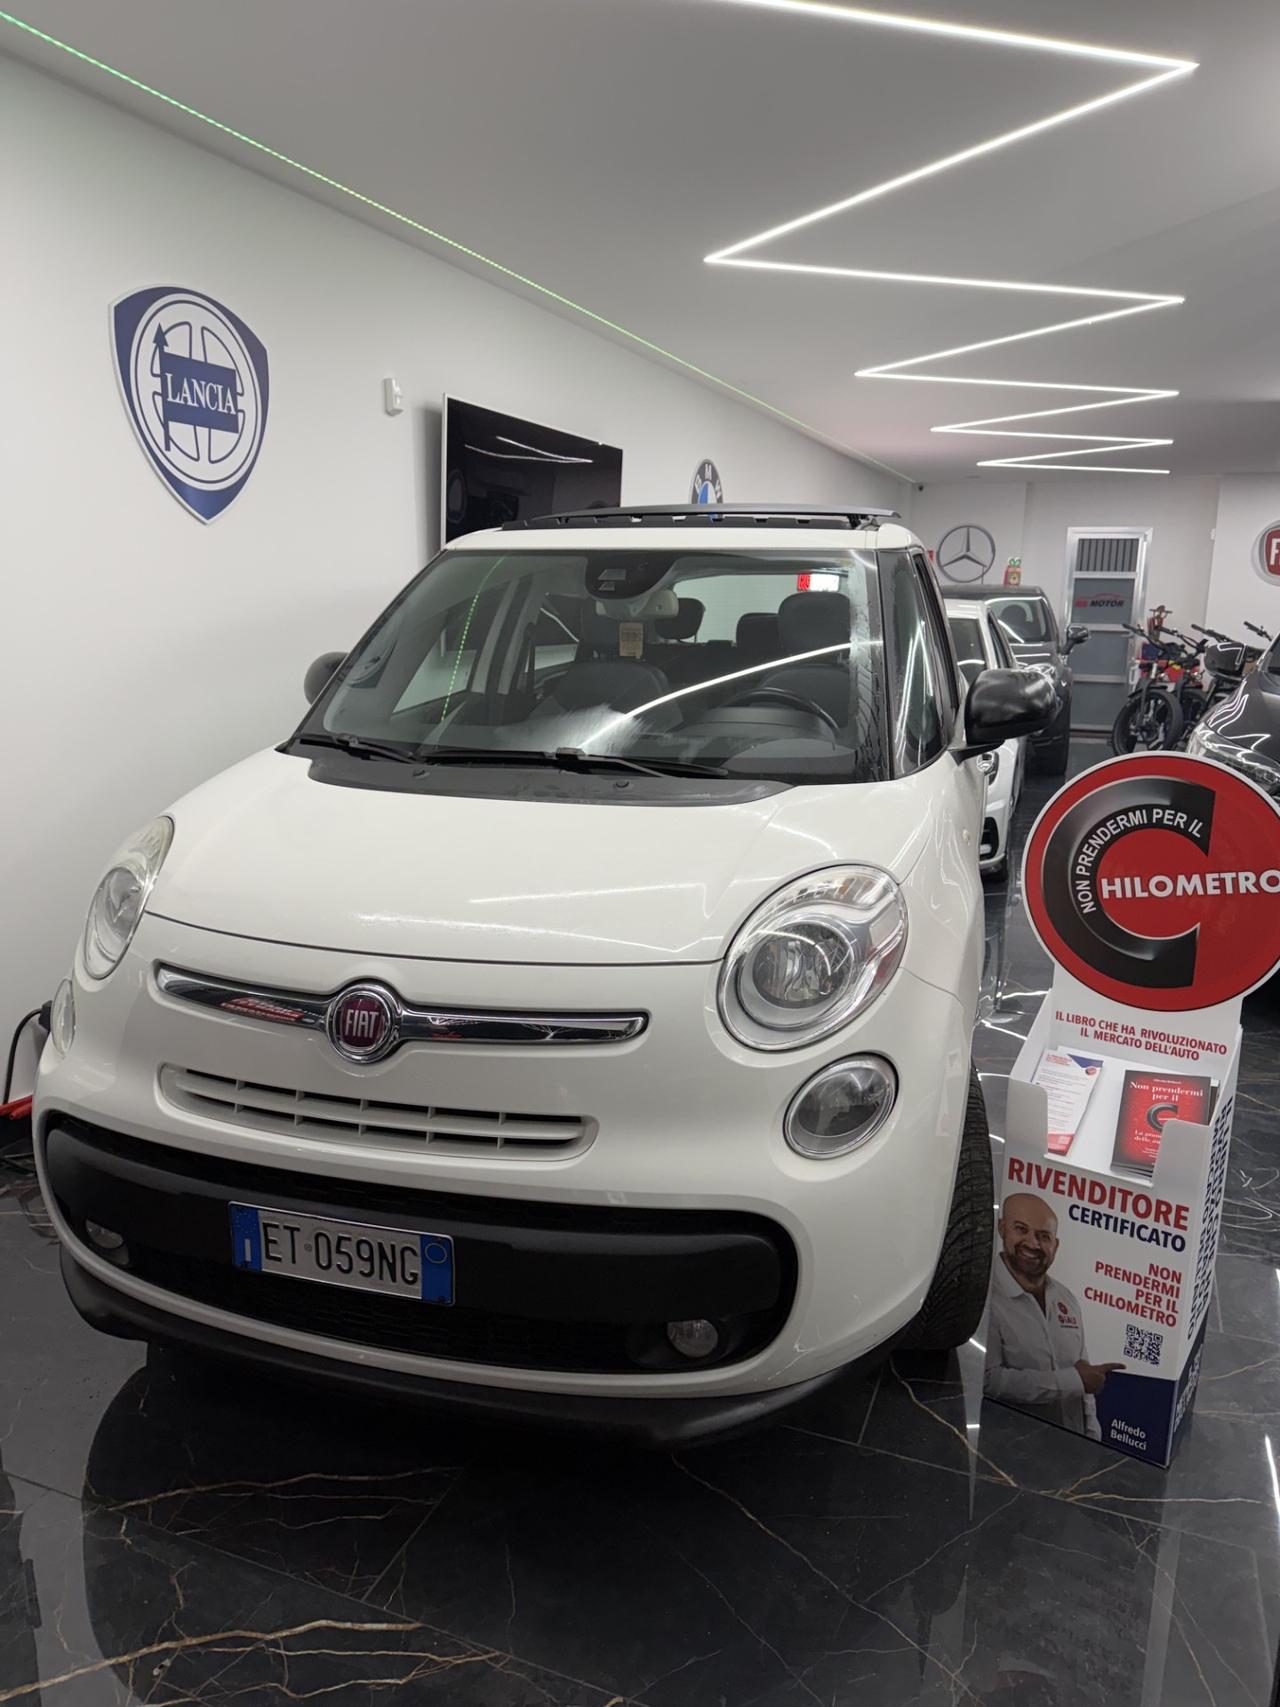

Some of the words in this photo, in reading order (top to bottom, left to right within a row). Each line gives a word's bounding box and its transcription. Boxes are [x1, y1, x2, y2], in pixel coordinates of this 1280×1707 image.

[165, 372, 237, 416] LANCIA
[1090, 599, 1124, 608] MOTOR
[1152, 808, 1188, 828] PER
[1188, 818, 1202, 838] IL
[1076, 810, 1148, 877] PRENDERMI
[1076, 880, 1097, 914] NON
[344, 1008, 379, 1039] FIAT
[1056, 1010, 1065, 1022] IL
[1066, 1013, 1096, 1028] LIBRO
[1098, 1018, 1119, 1034] CHE
[1121, 1024, 1136, 1036] HA
[1140, 1028, 1228, 1056] RIVOLUZIONATO
[1080, 1027, 1090, 1038] IL
[1093, 1029, 1143, 1049] MERCATO
[1144, 1040, 1200, 1061] DELL'AUTO
[1130, 1081, 1150, 1090] Non
[1152, 1085, 1204, 1097] prendermi
[1152, 1093, 1170, 1101] per
[1171, 1094, 1179, 1102] il
[1008, 1157, 1190, 1232] RIVENDITORE
[1068, 1204, 1186, 1252] CERTIFICATO
[1095, 1261, 1181, 1299] PRENDERMI
[1148, 1263, 1182, 1285] NON
[1084, 1286, 1177, 1328] CHILOMETRO
[1135, 1288, 1163, 1308] PER
[1166, 1297, 1179, 1314] IL
[1110, 1429, 1147, 1451] Bellucci
[1111, 1418, 1146, 1439] Alfredo
